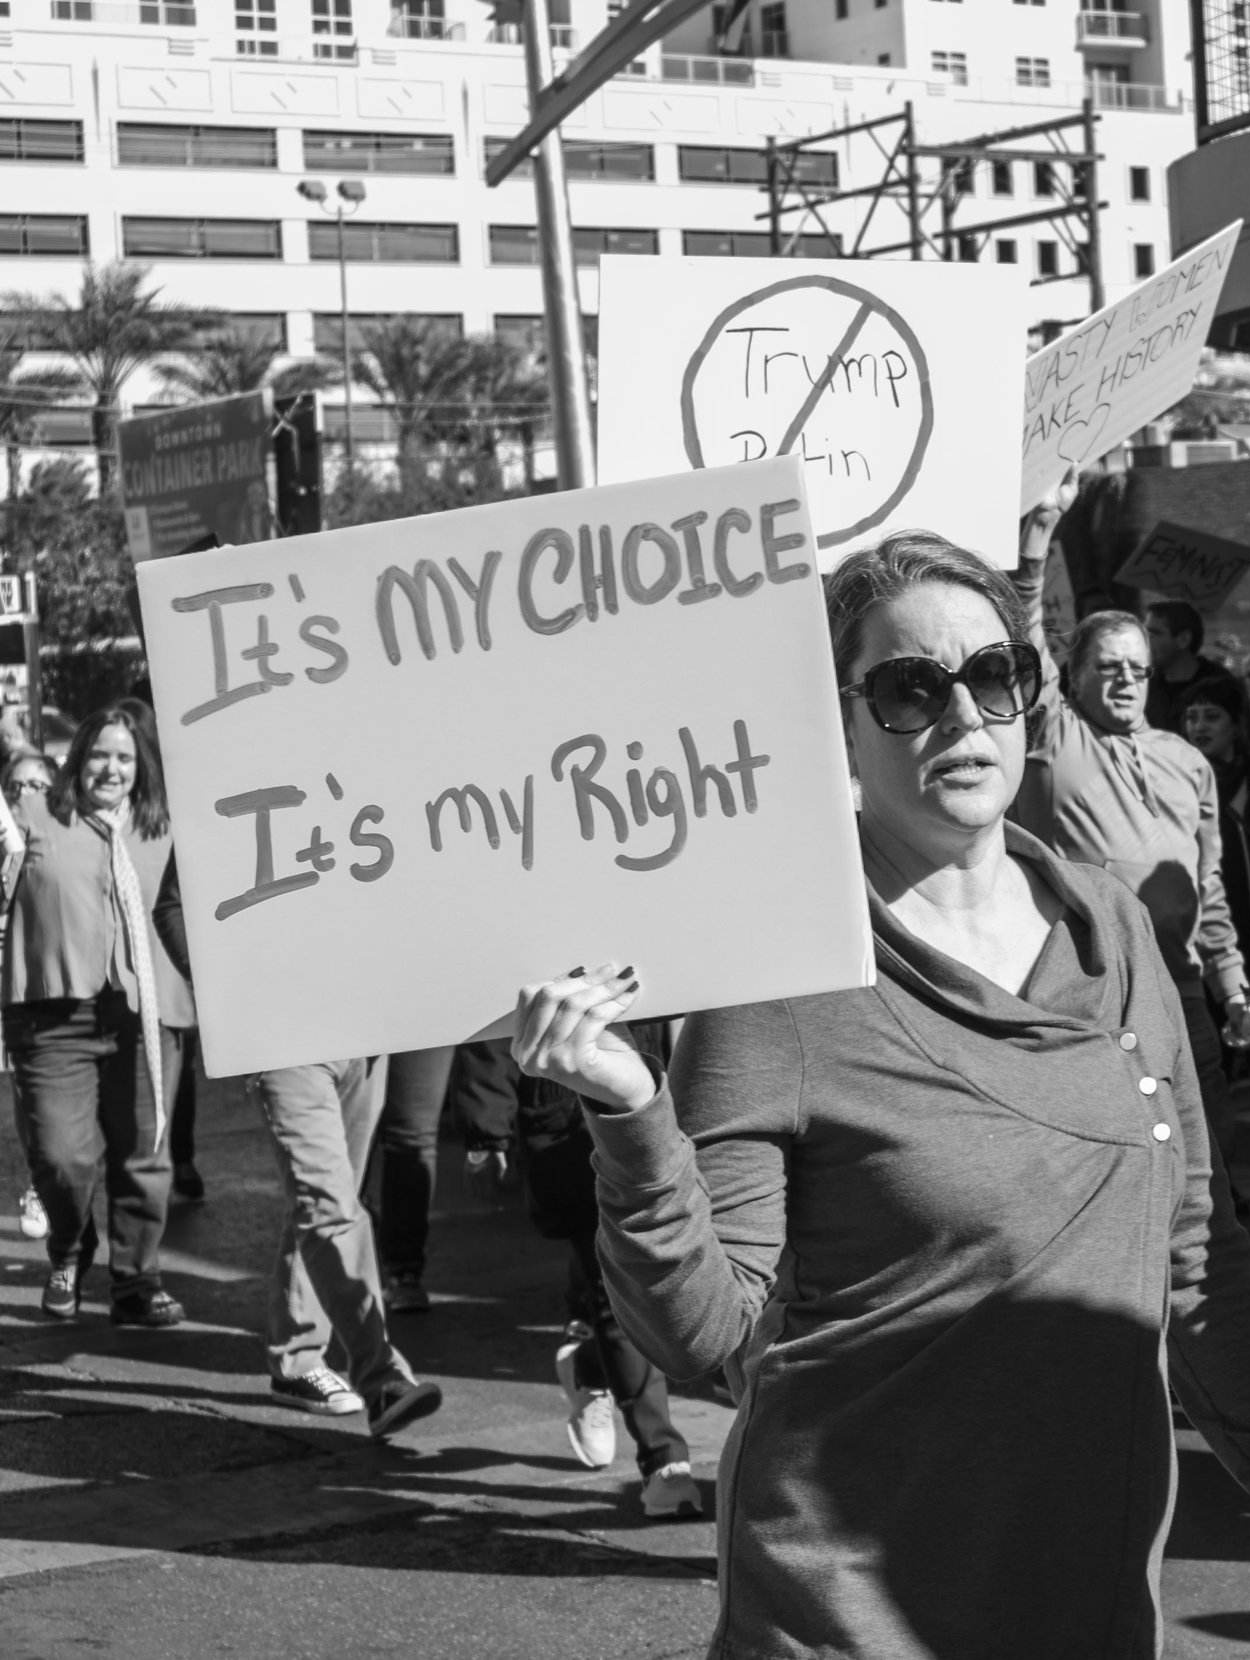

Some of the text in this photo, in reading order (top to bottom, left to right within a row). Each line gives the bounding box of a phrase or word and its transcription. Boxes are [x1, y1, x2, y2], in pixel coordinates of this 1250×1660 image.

[1128, 242, 1230, 333] WOMEN
[725, 327, 908, 408] Trump
[1096, 301, 1203, 402] HISTORY
[124, 435, 265, 498] CONTAINER PARK
[154, 422, 223, 450] DOWNTOWN
[730, 430, 871, 481] Ptin
[170, 498, 812, 727] It's MY CHOICE
[213, 718, 771, 922] It's my Right
